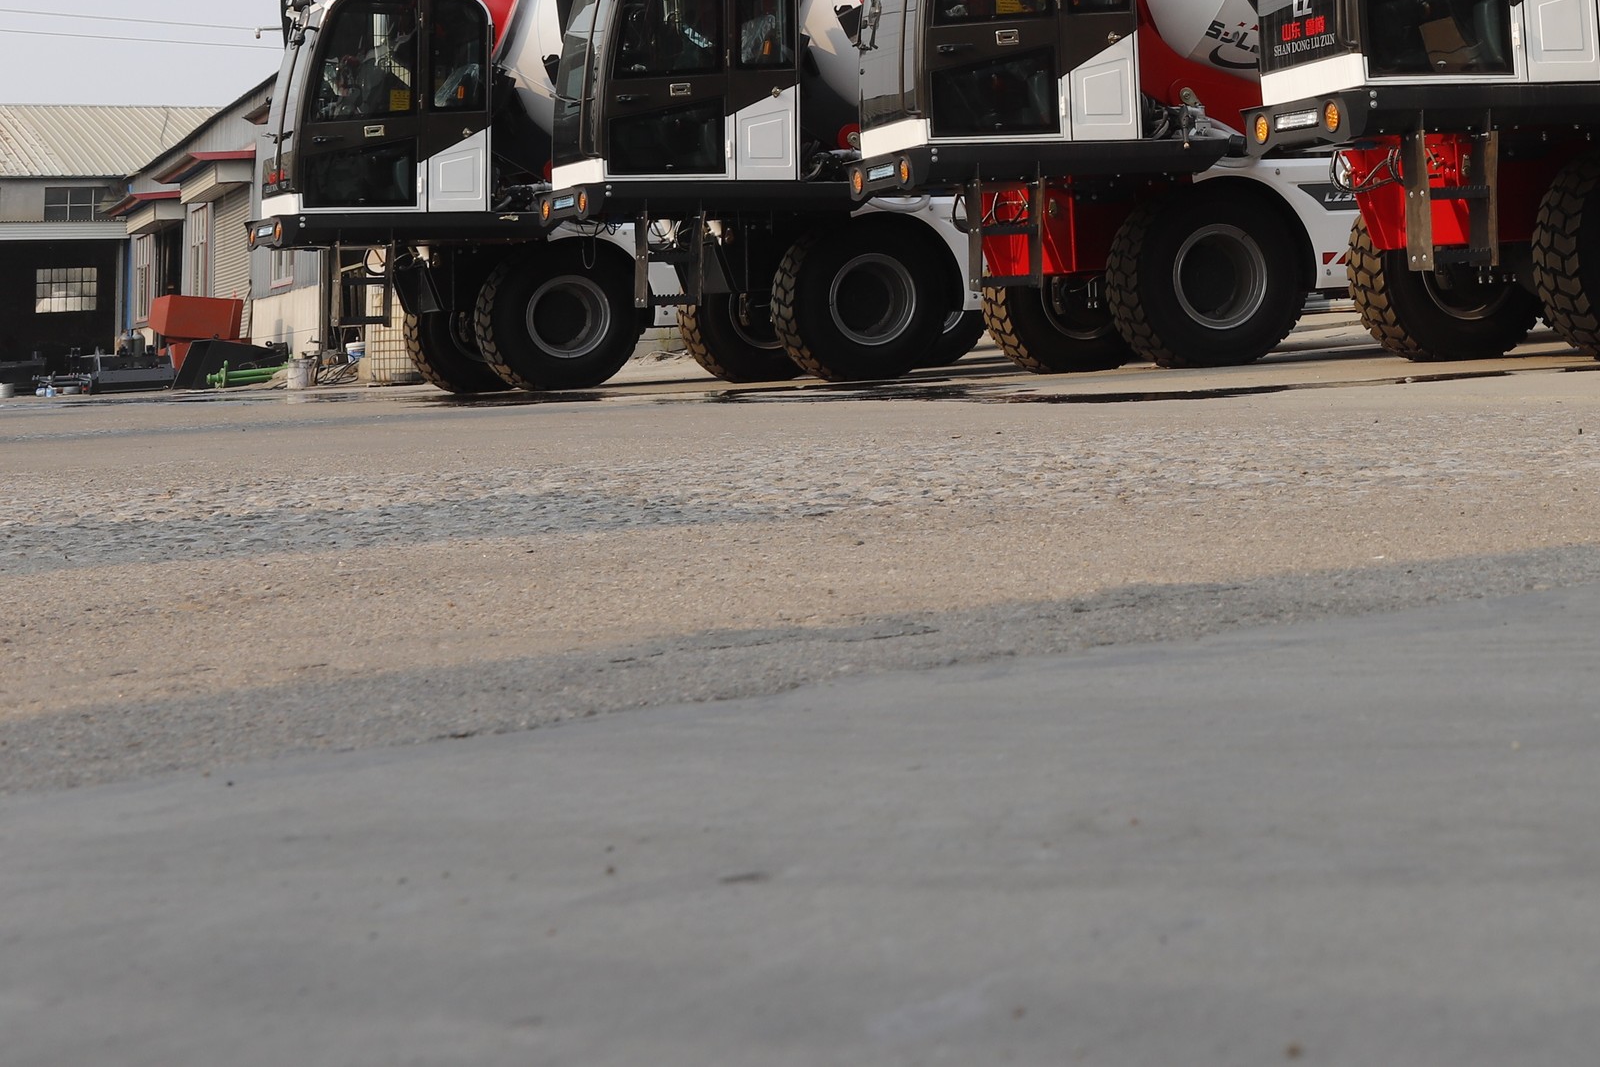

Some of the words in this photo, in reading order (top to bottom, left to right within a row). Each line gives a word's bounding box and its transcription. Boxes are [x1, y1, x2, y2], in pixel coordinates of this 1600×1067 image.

[1282, 21, 1301, 42] 山东
[1274, 43, 1291, 57] SHAN
[1292, 38, 1310, 54] DONG
[1320, 33, 1335, 47] ZUN
